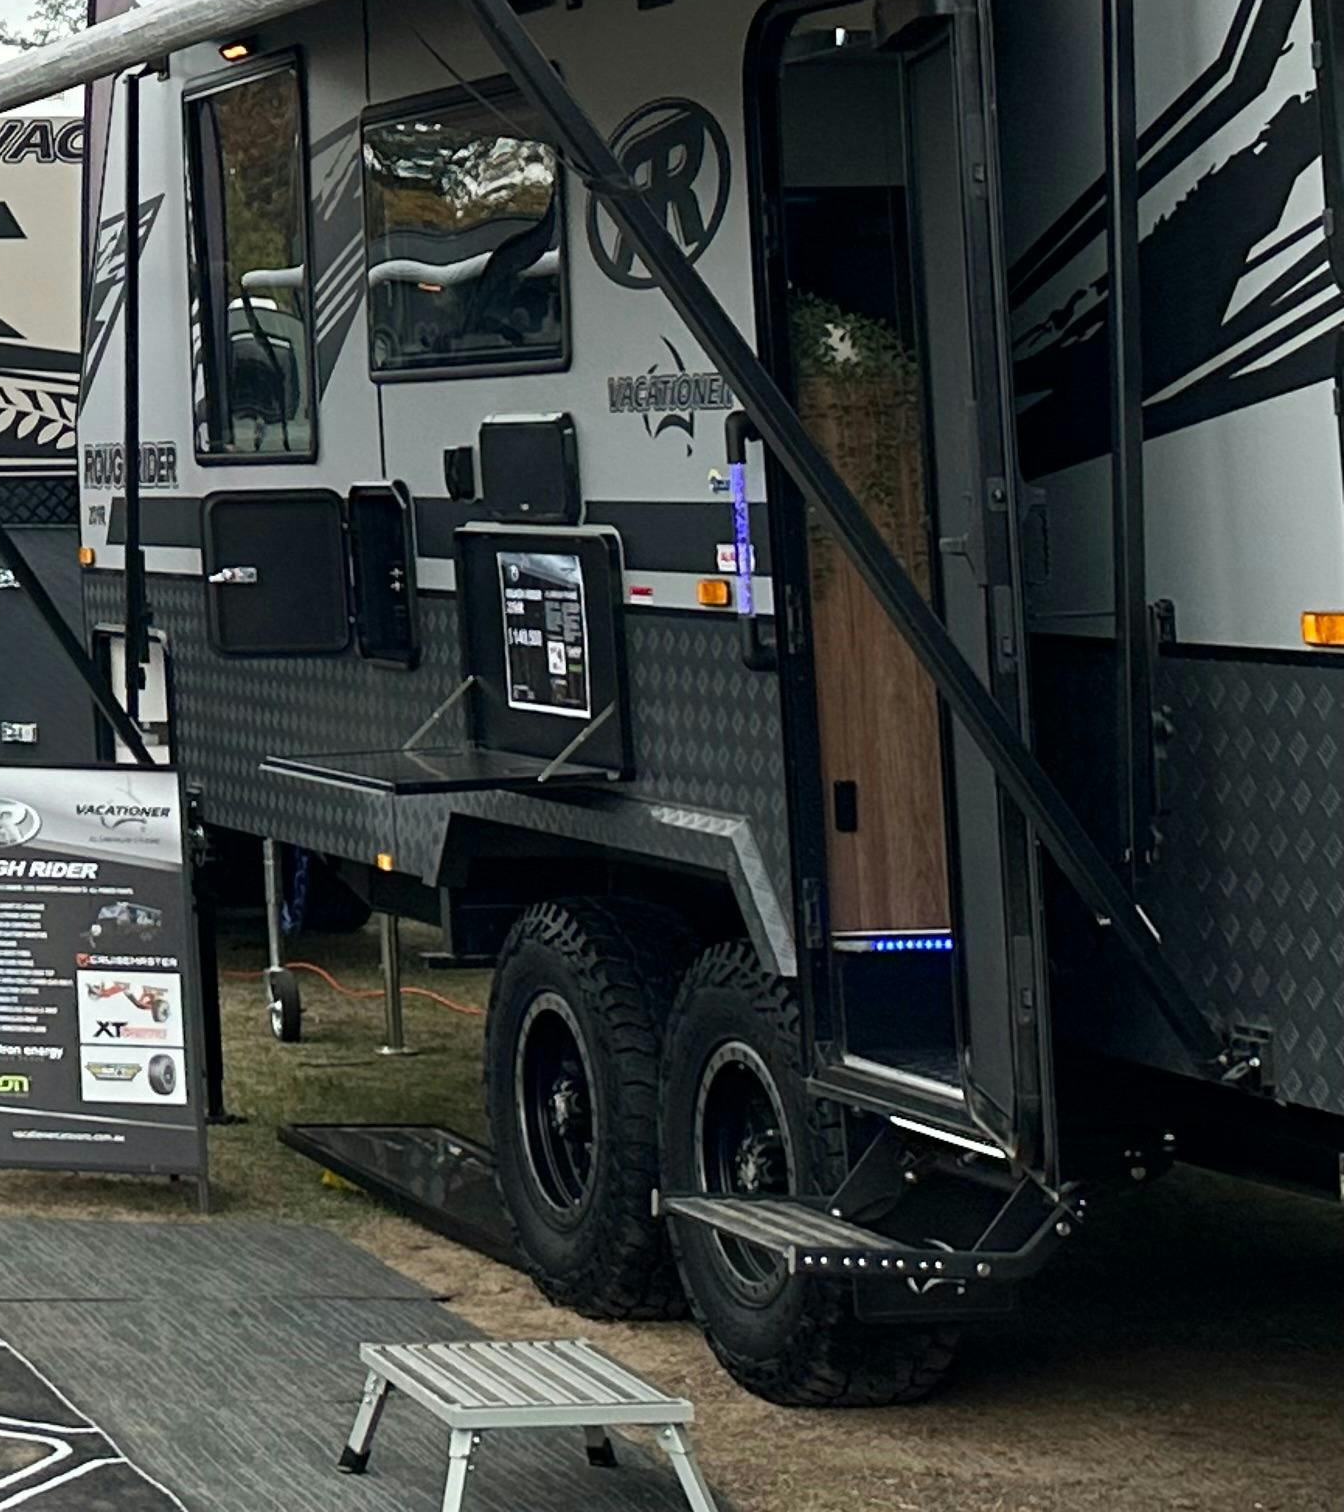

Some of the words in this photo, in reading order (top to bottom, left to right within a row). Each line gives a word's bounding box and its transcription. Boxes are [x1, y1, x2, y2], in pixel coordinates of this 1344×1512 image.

[75, 804, 171, 818] VACATIONER
[28, 860, 99, 880] RIDER
[94, 1020, 128, 1039] XT
[23, 1045, 64, 1061] energy
